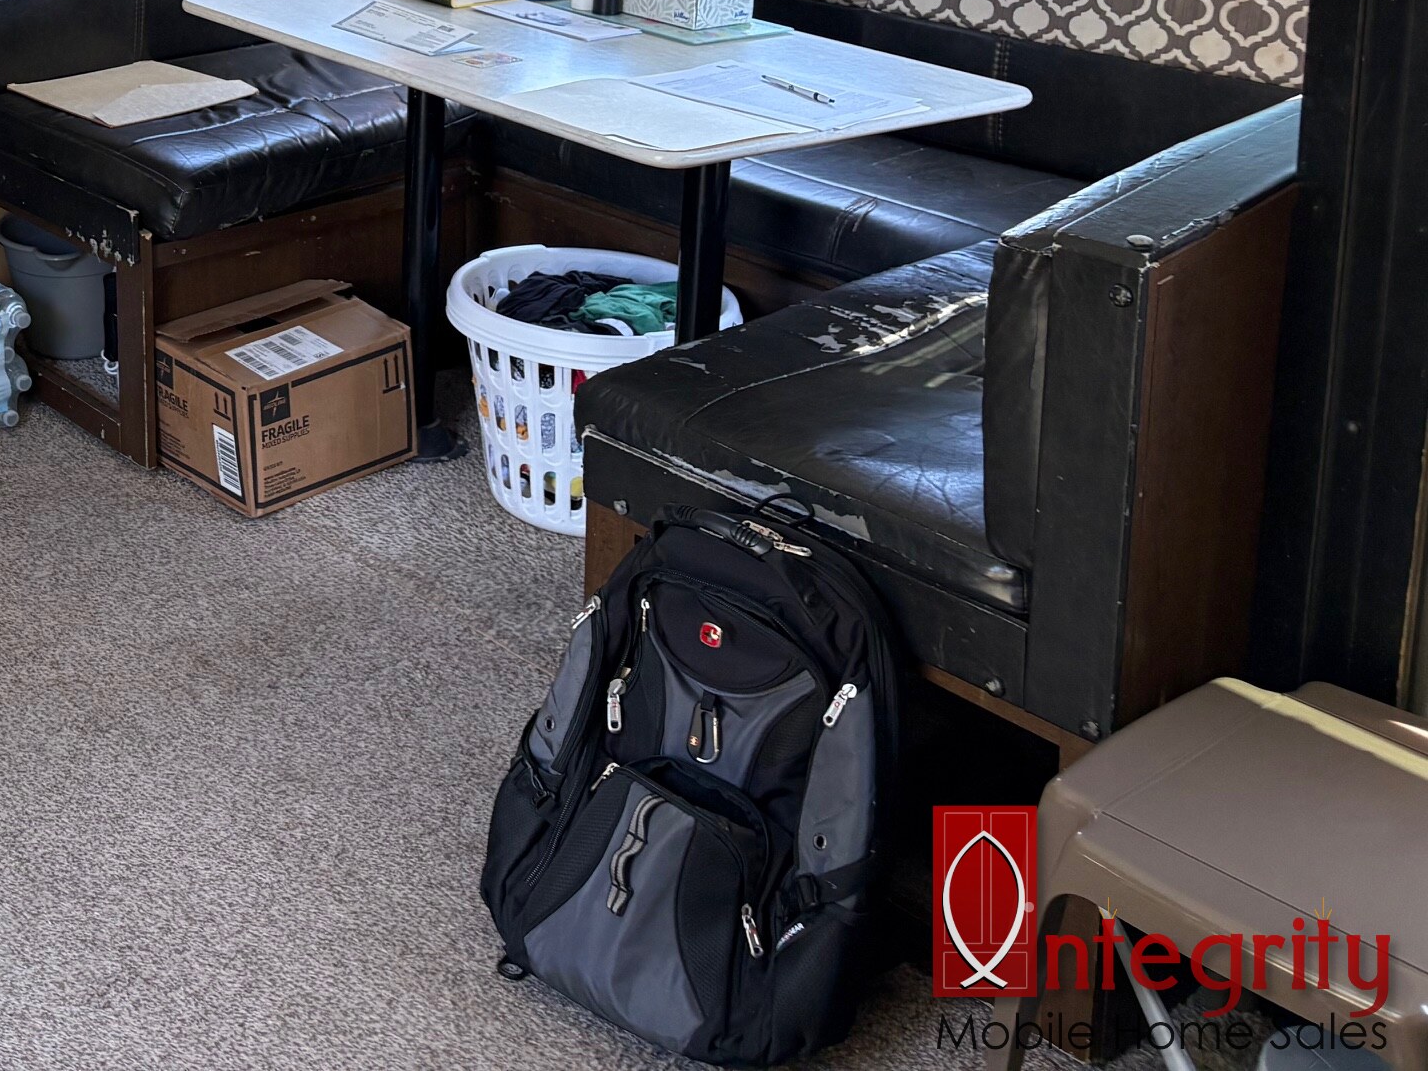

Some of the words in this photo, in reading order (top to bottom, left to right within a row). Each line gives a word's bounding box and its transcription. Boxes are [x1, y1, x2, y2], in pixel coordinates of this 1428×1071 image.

[262, 415, 310, 442] FRAGILE
[262, 438, 282, 450] MIXED
[281, 428, 310, 443] SUPPLIES
